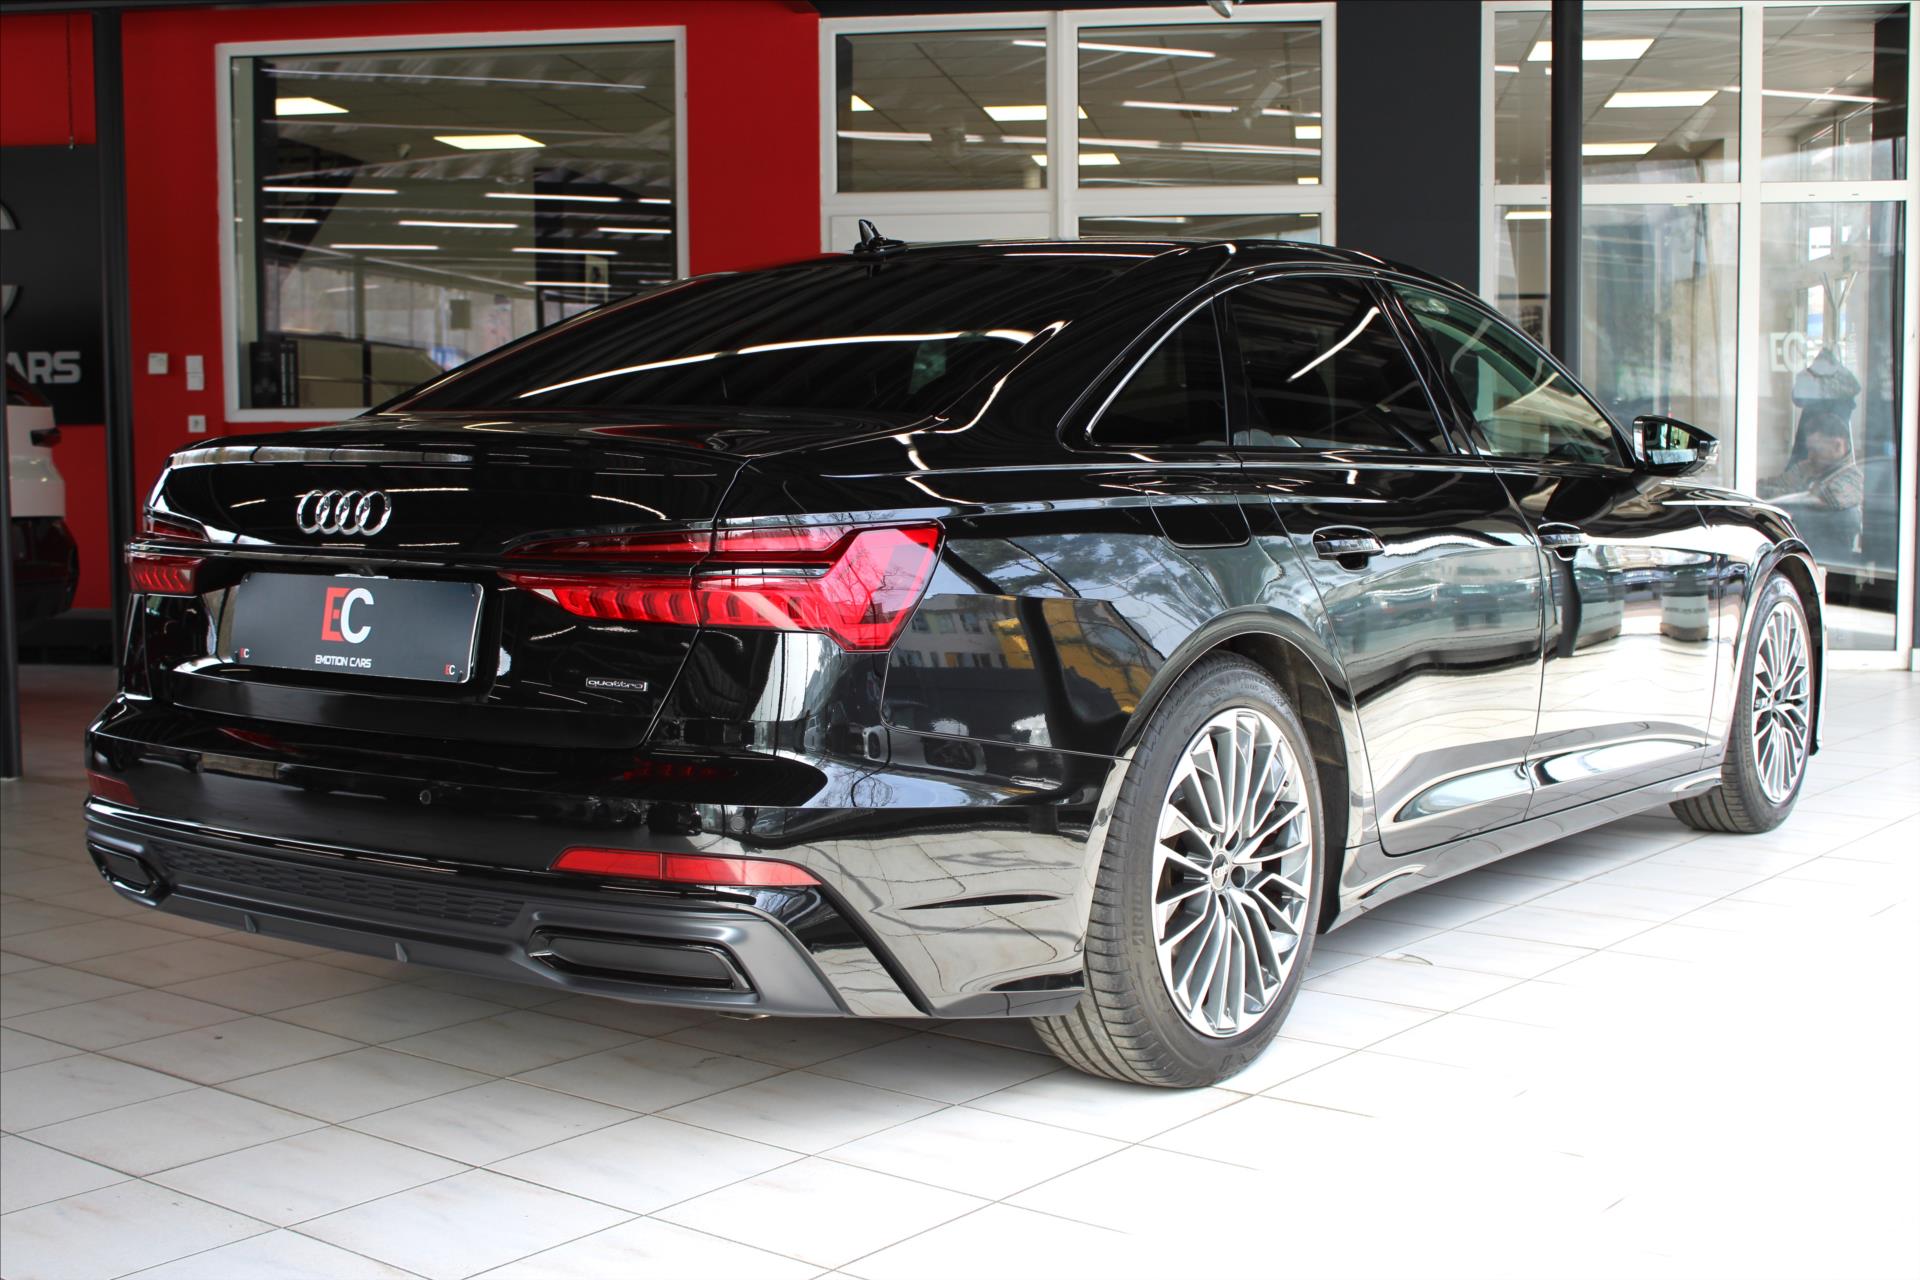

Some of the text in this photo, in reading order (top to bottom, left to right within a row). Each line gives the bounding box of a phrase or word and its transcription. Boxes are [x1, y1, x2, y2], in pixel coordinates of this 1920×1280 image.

[321, 586, 374, 643] EC
[315, 654, 372, 668] EMOTION CARS
[588, 680, 645, 690] quattro
